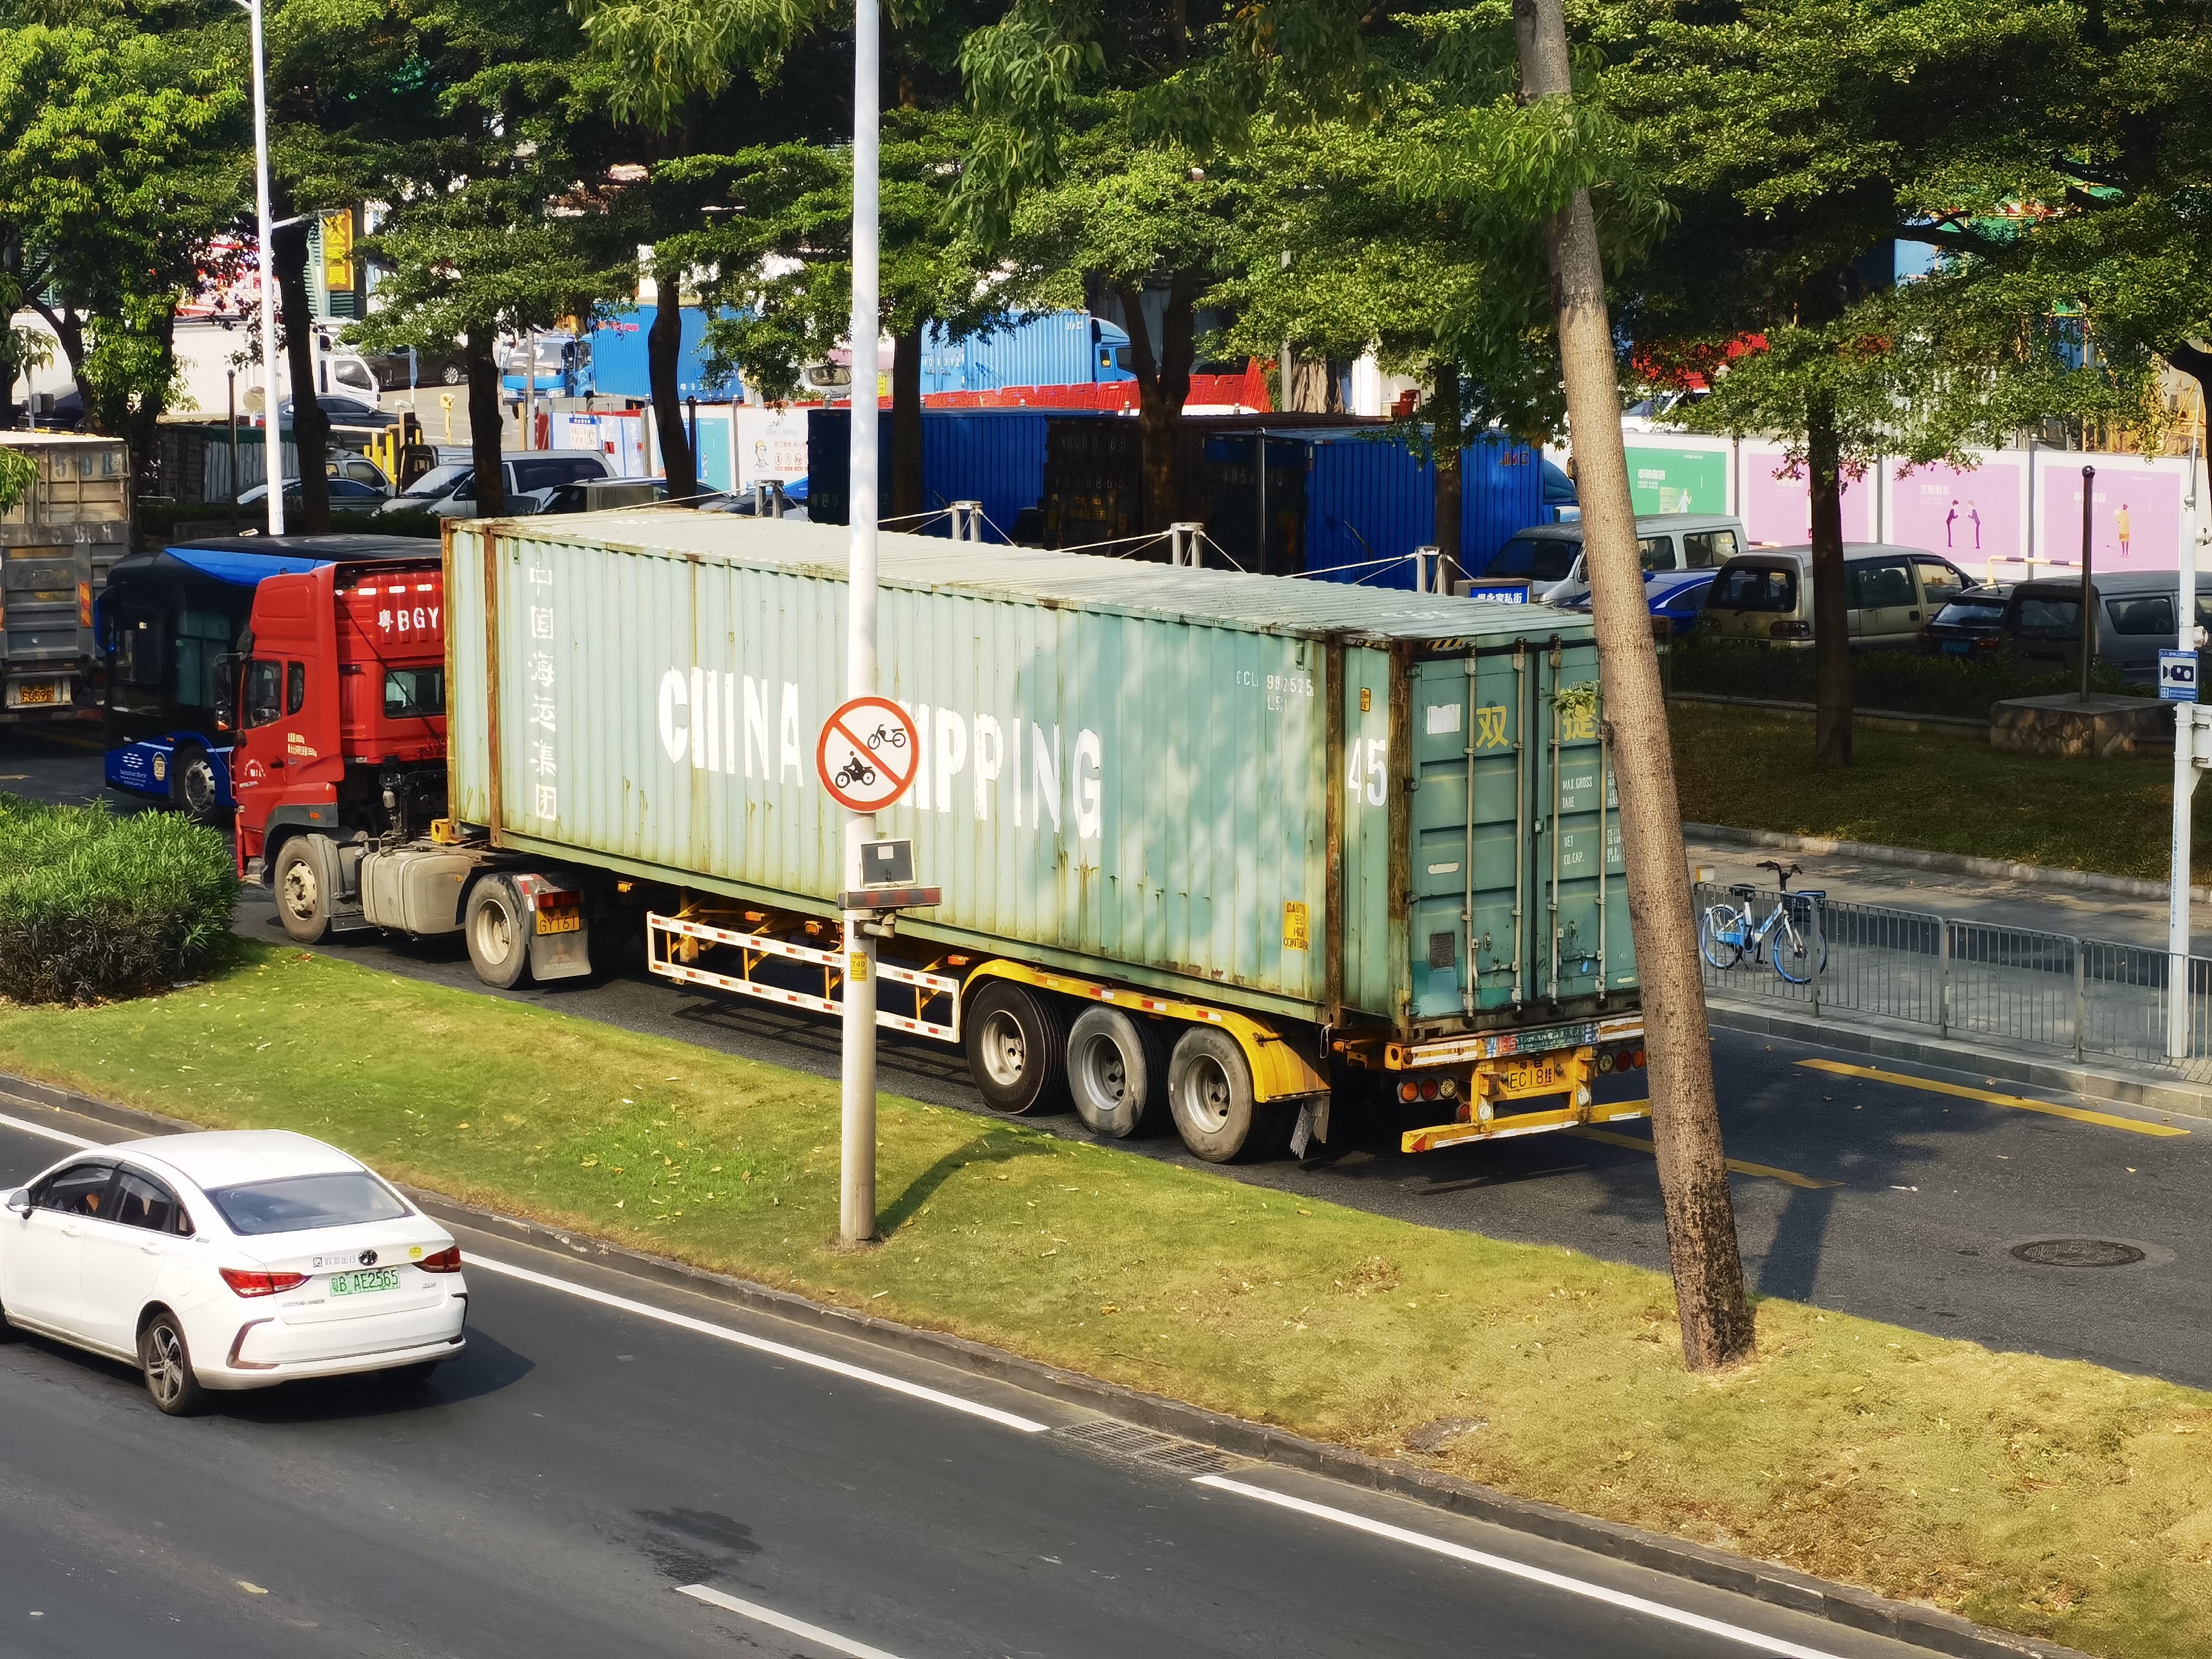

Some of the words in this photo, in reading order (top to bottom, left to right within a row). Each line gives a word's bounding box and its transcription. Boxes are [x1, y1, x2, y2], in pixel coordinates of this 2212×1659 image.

[1920, 484, 1951, 495] 文明有礼
[528, 561, 557, 820] 中国海运集团
[1476, 705, 1508, 749] 双
[896, 699, 1101, 839] IPPING
[1348, 737, 1387, 806] 45
[1562, 776, 1593, 791] MAX.GROSS
[1562, 797, 1575, 809] TARE
[1564, 834, 1573, 847] NET
[539, 915, 575, 933] GY161
